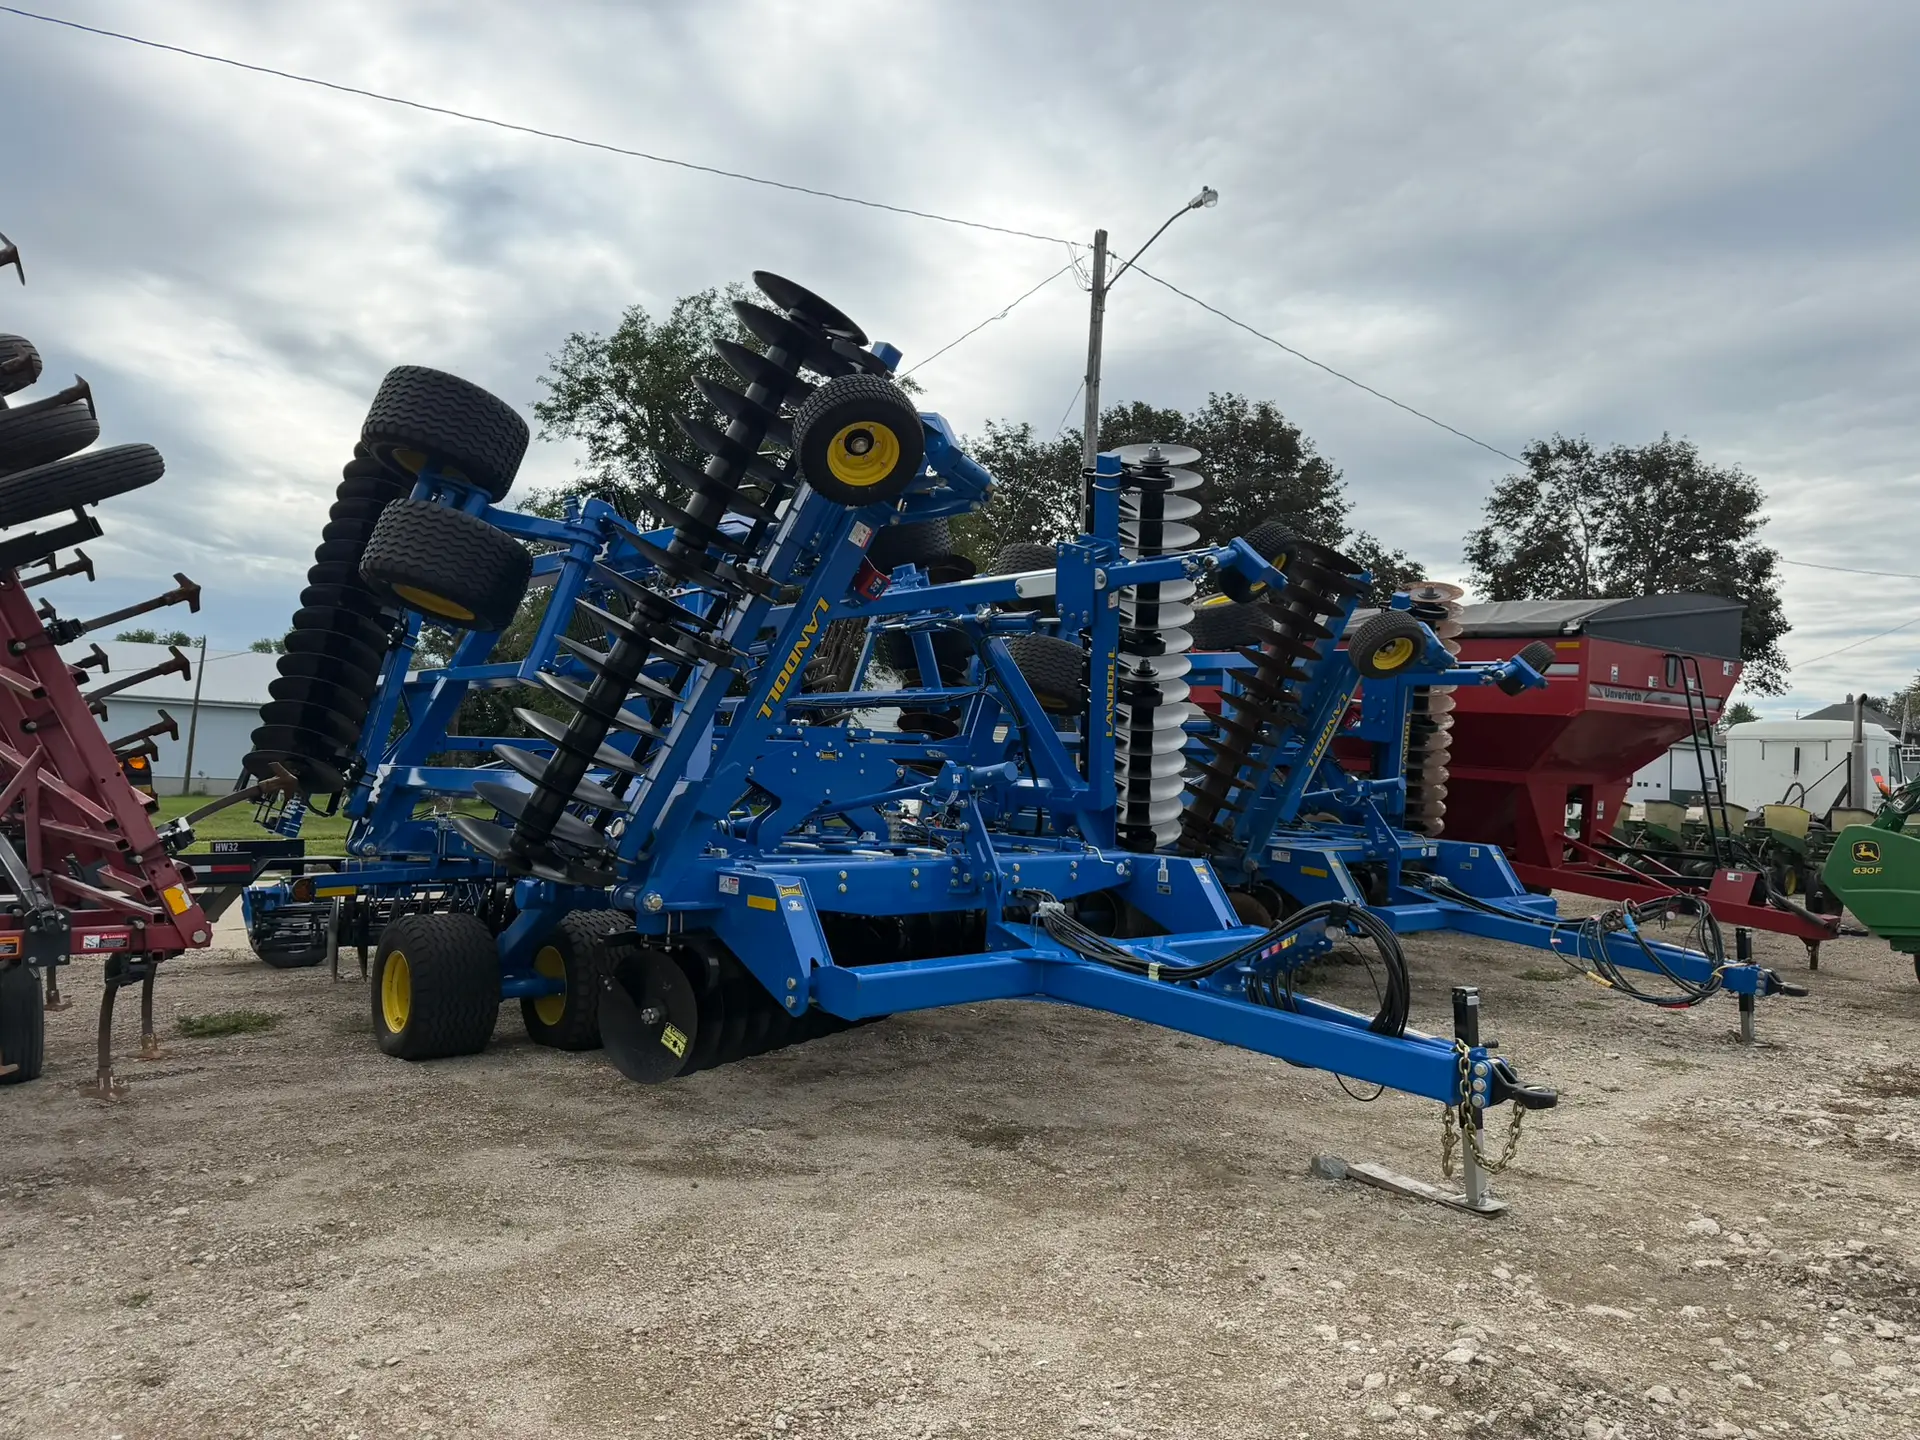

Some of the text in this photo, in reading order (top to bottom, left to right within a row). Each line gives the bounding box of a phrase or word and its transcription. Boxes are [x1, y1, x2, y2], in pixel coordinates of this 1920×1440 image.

[756, 596, 830, 719] LANDOLL
[1105, 646, 1116, 737] LANDOLL
[1306, 692, 1347, 767] LANDOLL
[214, 842, 239, 852] HW32
[1852, 867, 1883, 875] 630F
